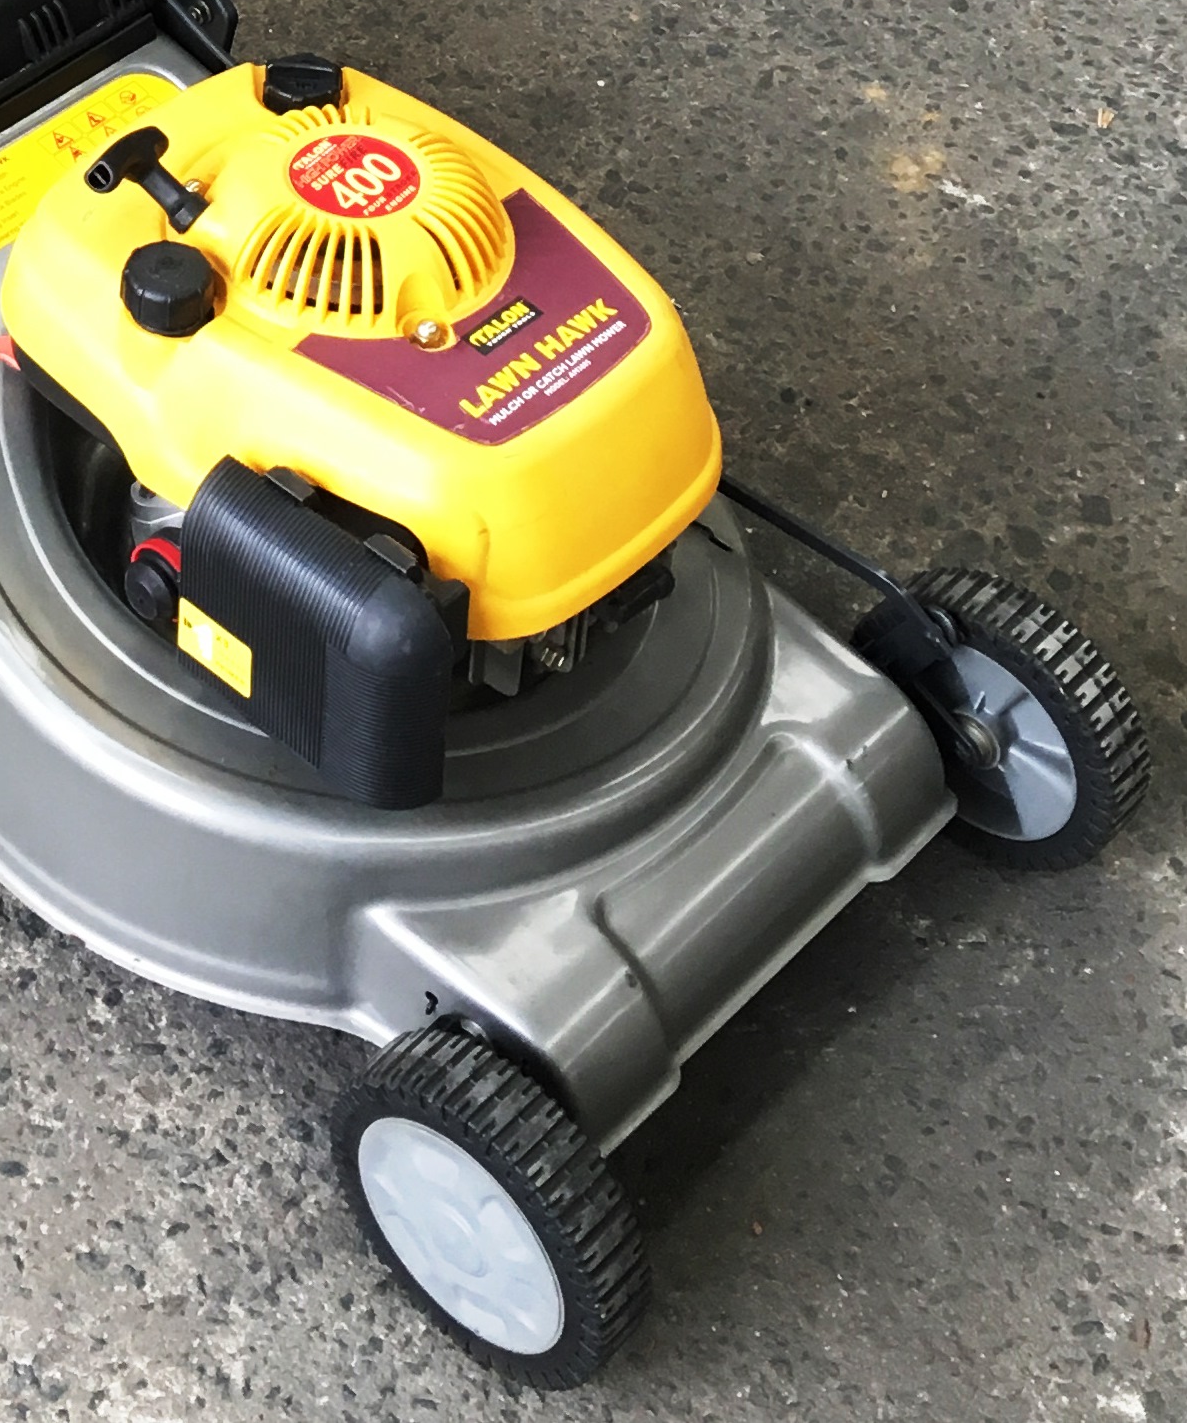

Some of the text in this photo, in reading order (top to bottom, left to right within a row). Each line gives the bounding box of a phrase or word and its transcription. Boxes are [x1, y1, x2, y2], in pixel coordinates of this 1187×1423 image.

[331, 154, 400, 208] 400
[460, 297, 618, 418] LAWN HAWK
[470, 301, 529, 345] TALON
[488, 319, 627, 425] MULCH OR CATCH LAWN MOWER
